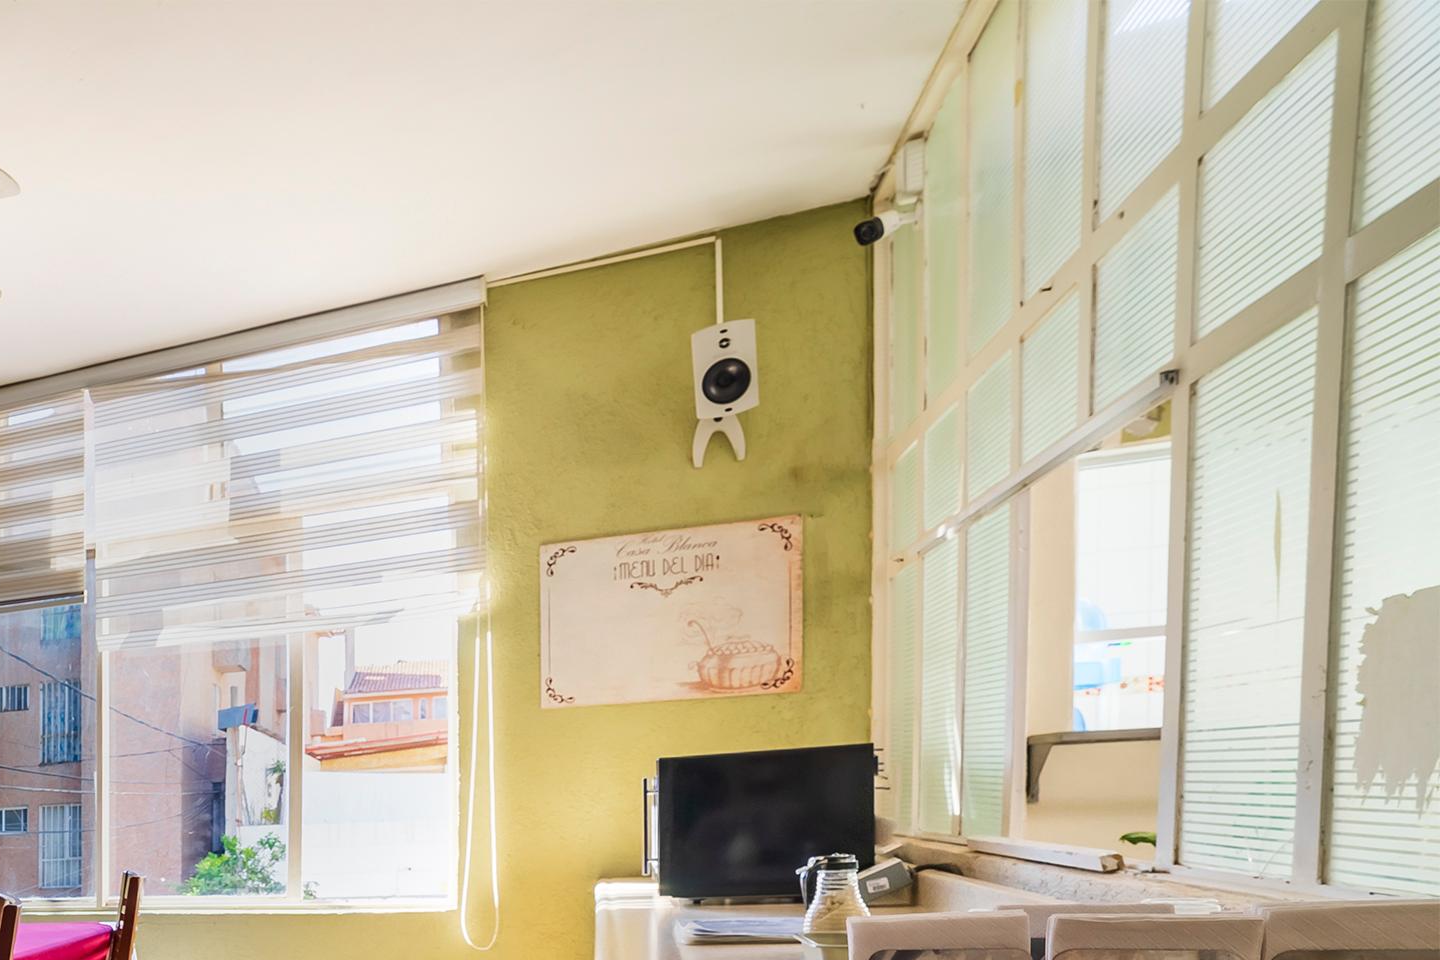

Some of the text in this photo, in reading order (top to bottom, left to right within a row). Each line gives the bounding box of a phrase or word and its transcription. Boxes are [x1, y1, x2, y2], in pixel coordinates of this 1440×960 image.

[615, 535, 718, 558] Casa Blanca
[662, 556, 688, 576] DEL
